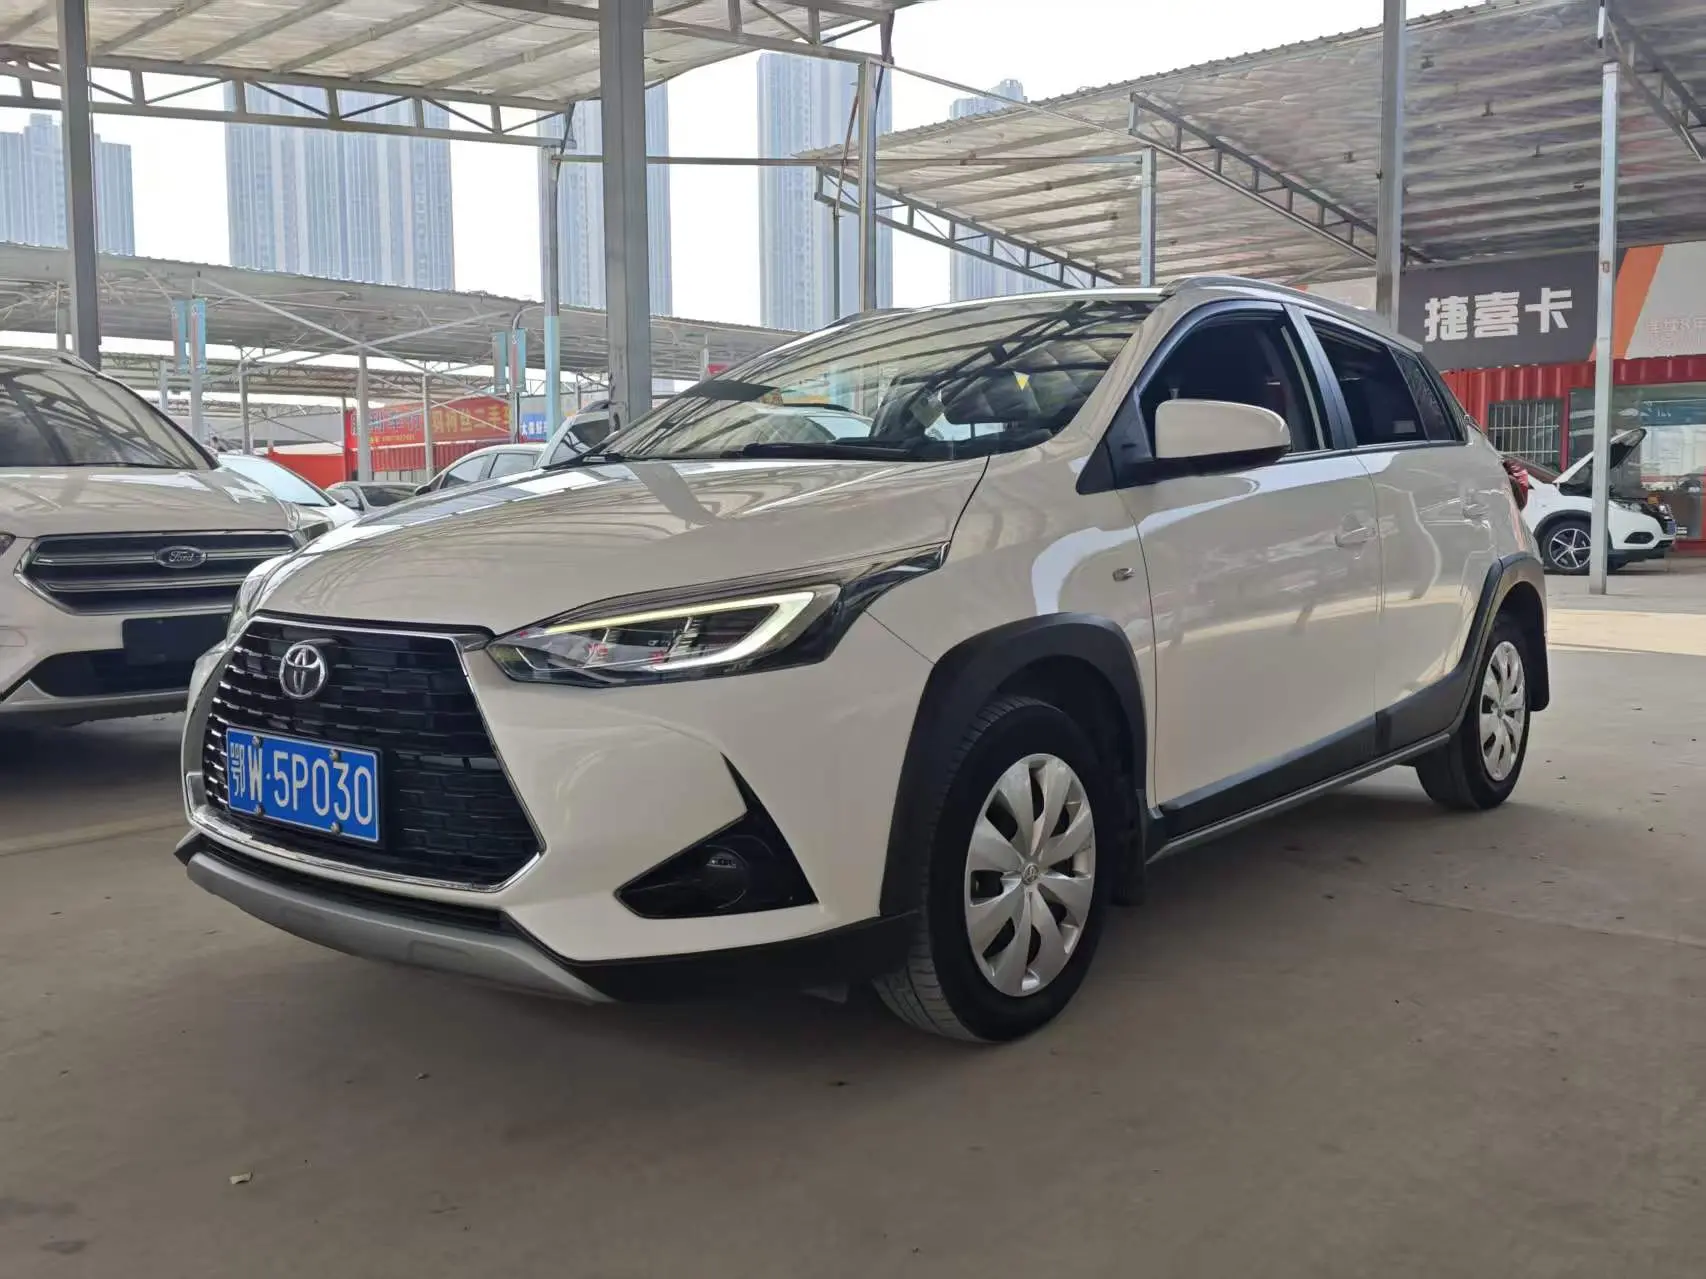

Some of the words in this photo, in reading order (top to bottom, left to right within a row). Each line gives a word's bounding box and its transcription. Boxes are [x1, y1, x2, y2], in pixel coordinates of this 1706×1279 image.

[1424, 287, 1573, 342] 捷喜卡
[168, 550, 194, 562] Ford
